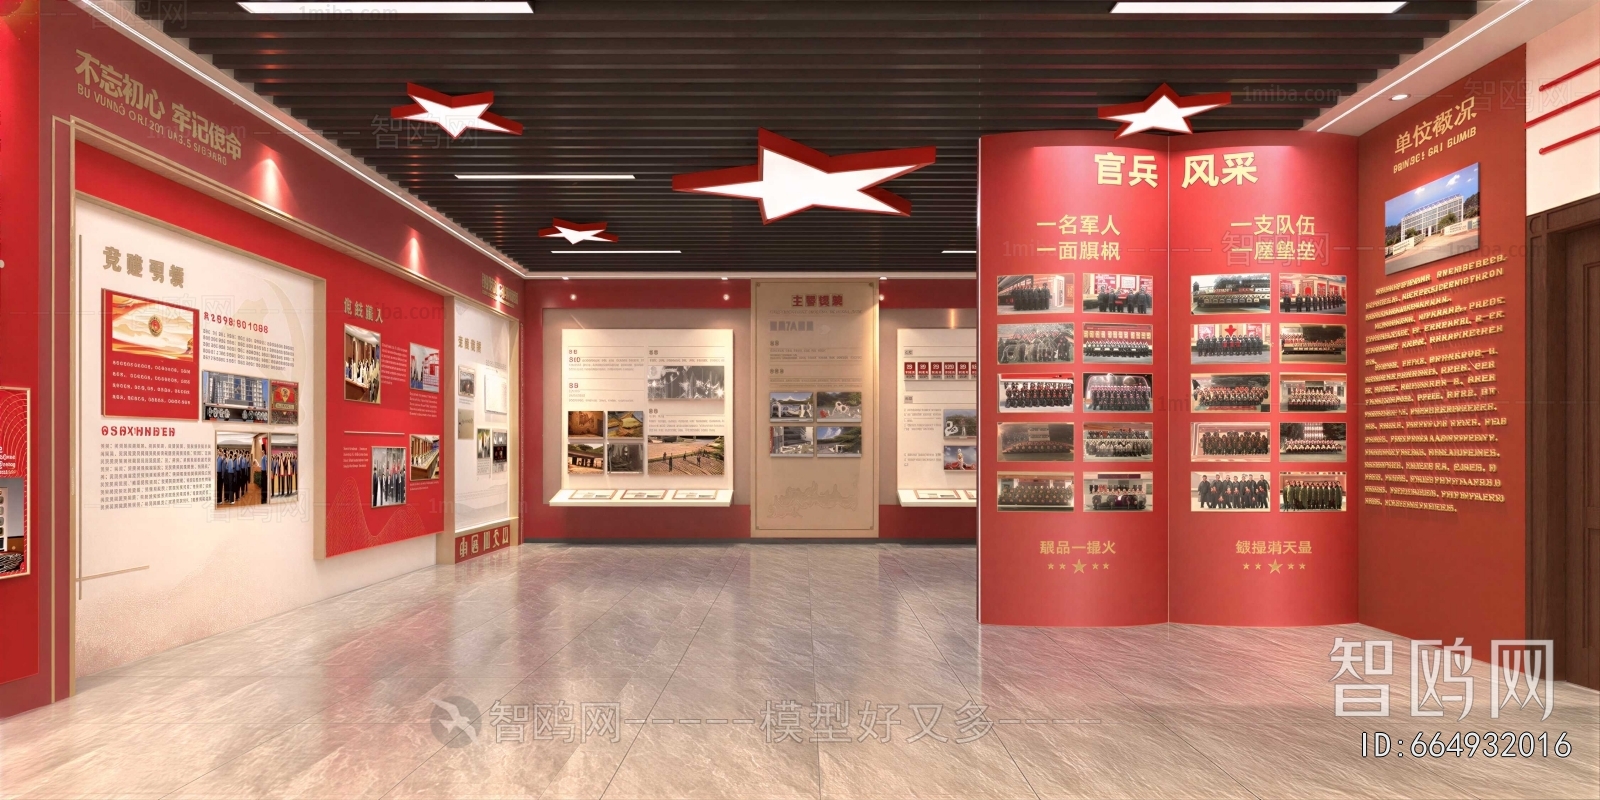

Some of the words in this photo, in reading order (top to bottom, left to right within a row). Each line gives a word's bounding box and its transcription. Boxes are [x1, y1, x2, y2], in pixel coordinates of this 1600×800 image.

[75, 49, 166, 120] 不忘初心
[171, 102, 242, 161] 牢记使命
[1094, 152, 1158, 188] 官兵
[1181, 152, 1258, 189] 风采
[1036, 214, 1121, 236] 一名军人
[1230, 214, 1315, 236] 一支队伍
